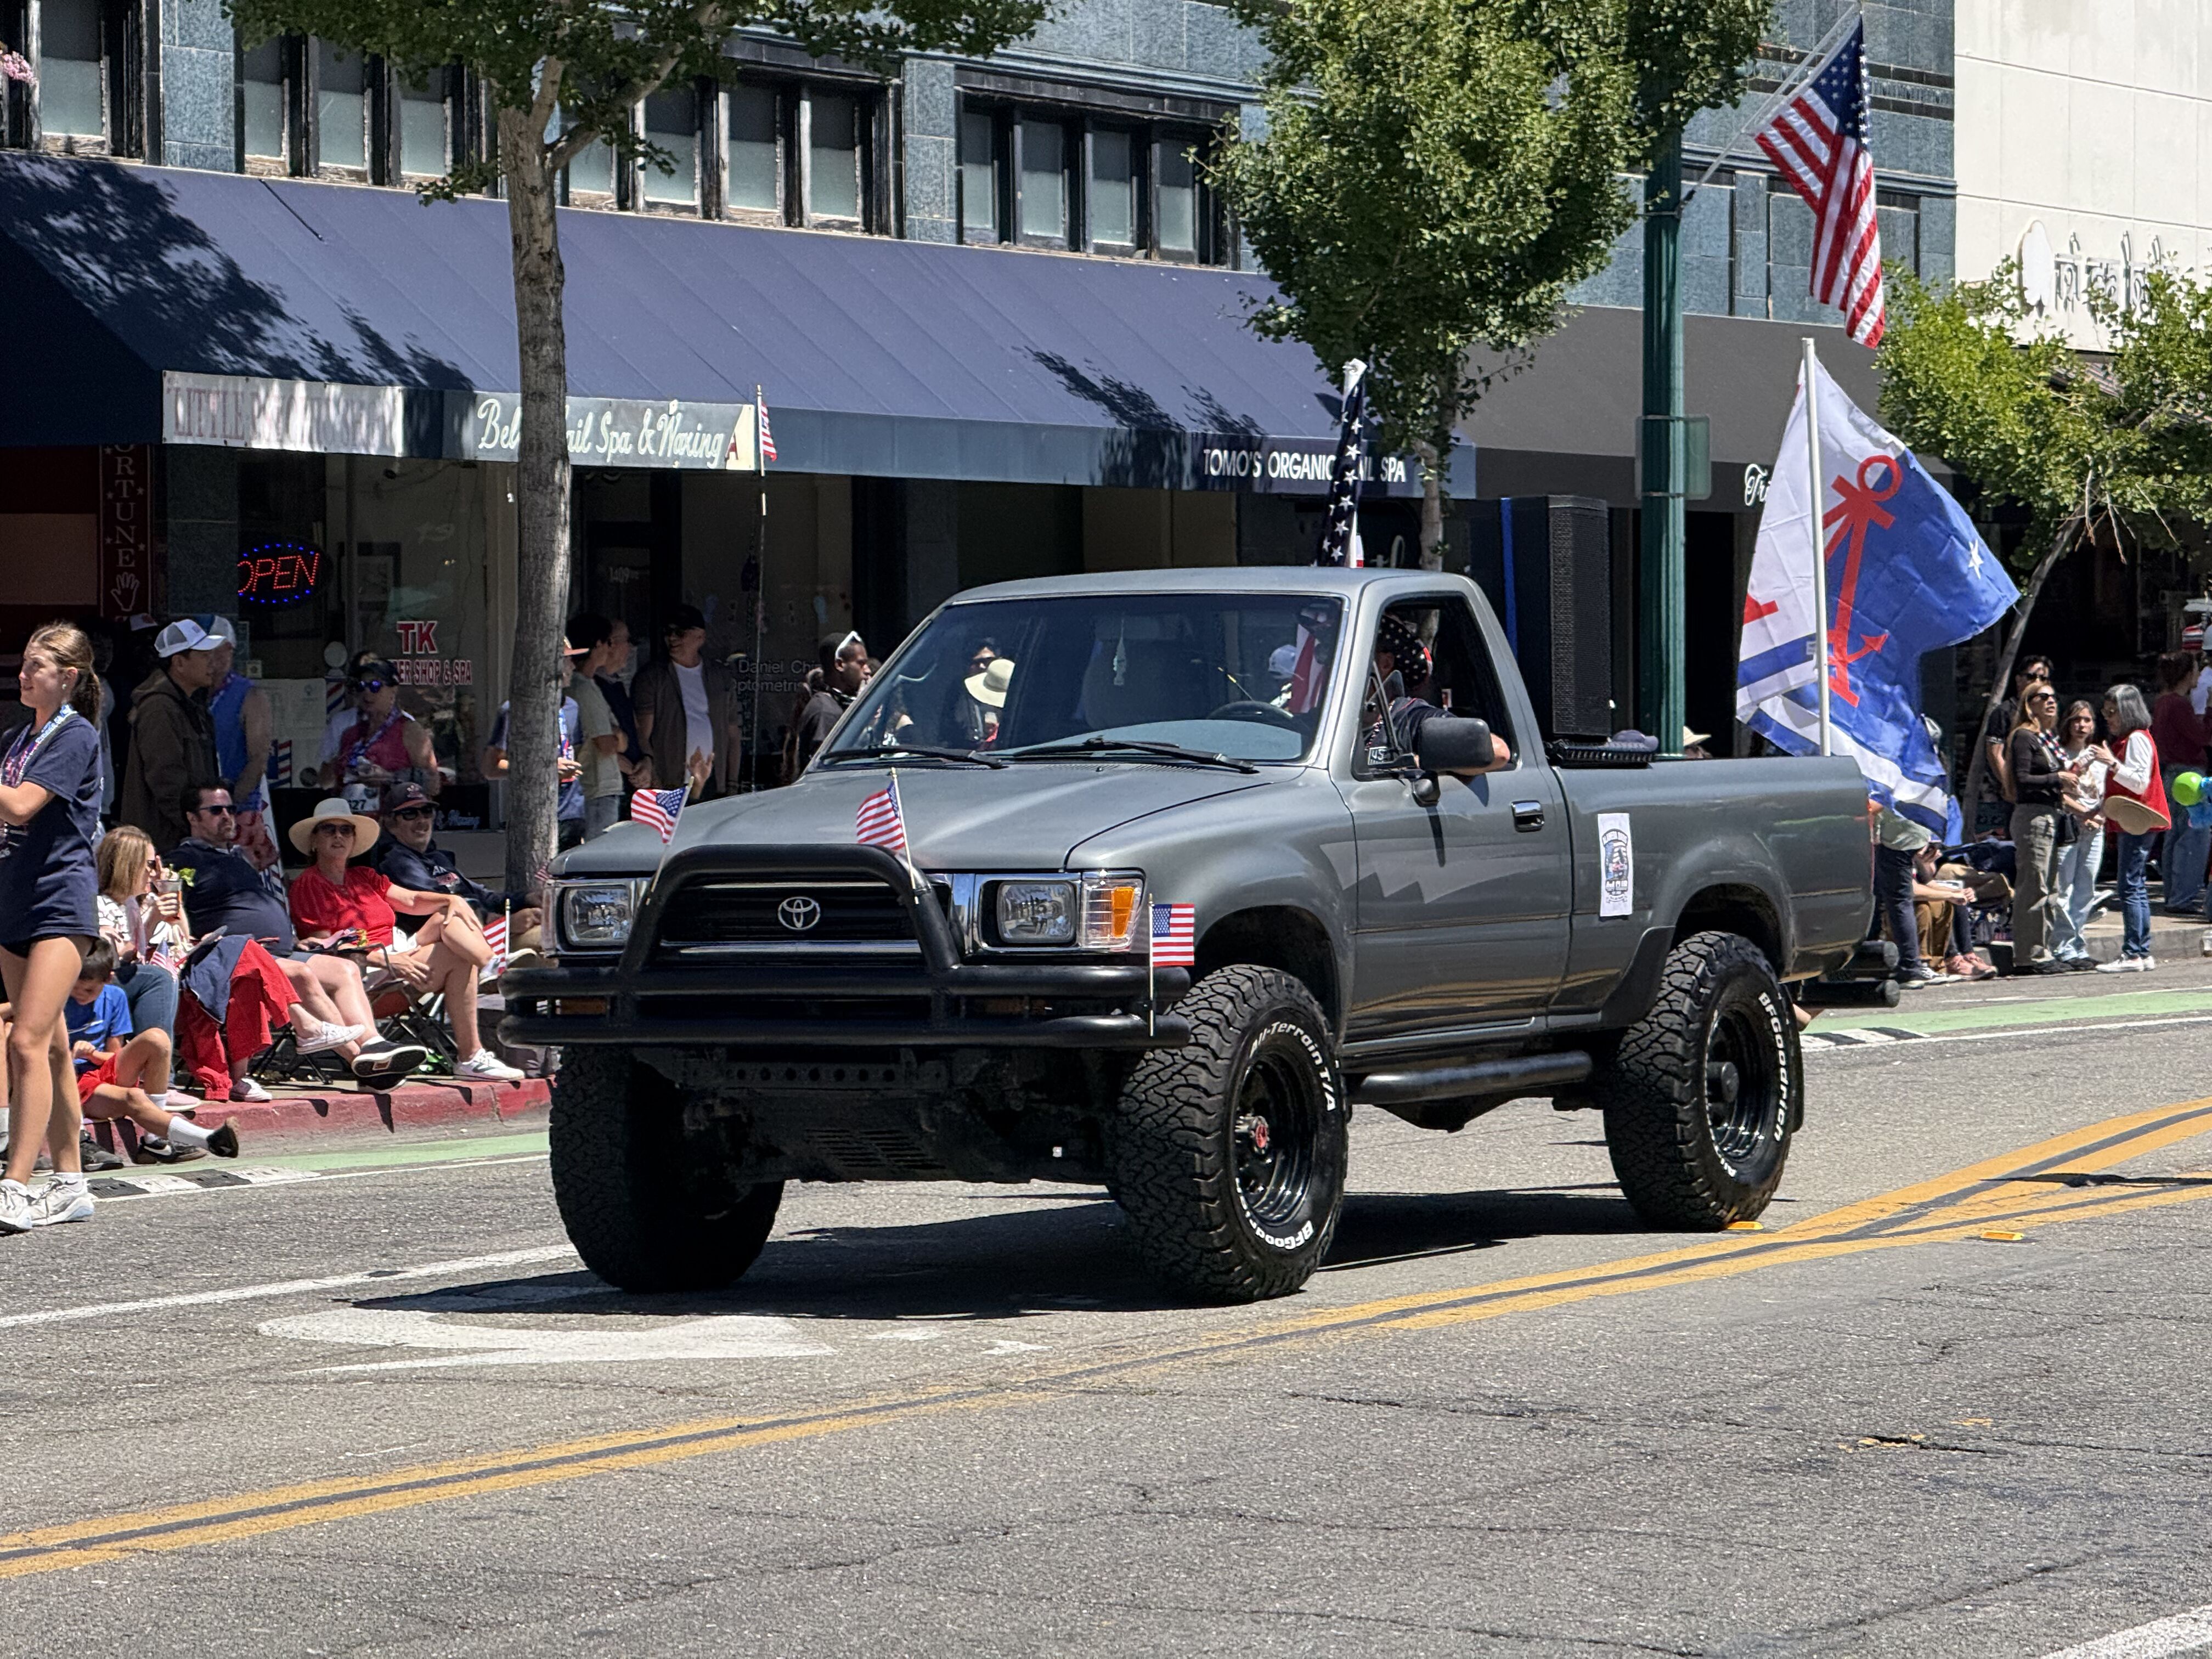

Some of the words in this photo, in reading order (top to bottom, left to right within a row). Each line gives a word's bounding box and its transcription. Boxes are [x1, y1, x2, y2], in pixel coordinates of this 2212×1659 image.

[565, 404, 592, 454] ail
[596, 411, 632, 462] Spa
[637, 408, 656, 455] &
[656, 412, 725, 469] Waxing
[1203, 448, 1261, 478] TOMO'S
[1267, 450, 1337, 481] ORGANIC
[1381, 456, 1407, 483] SPA
[397, 620, 438, 654] TK
[414, 659, 441, 685] SHOP
[443, 659, 451, 685] &
[453, 659, 472, 685] SPA
[738, 659, 783, 674] Daniel
[733, 678, 804, 695] ptometris
[1249, 1021, 1323, 1065] All-Terrain
[1319, 1066, 1336, 1111] T/A
[1758, 991, 1790, 1142] BFGoodrich
